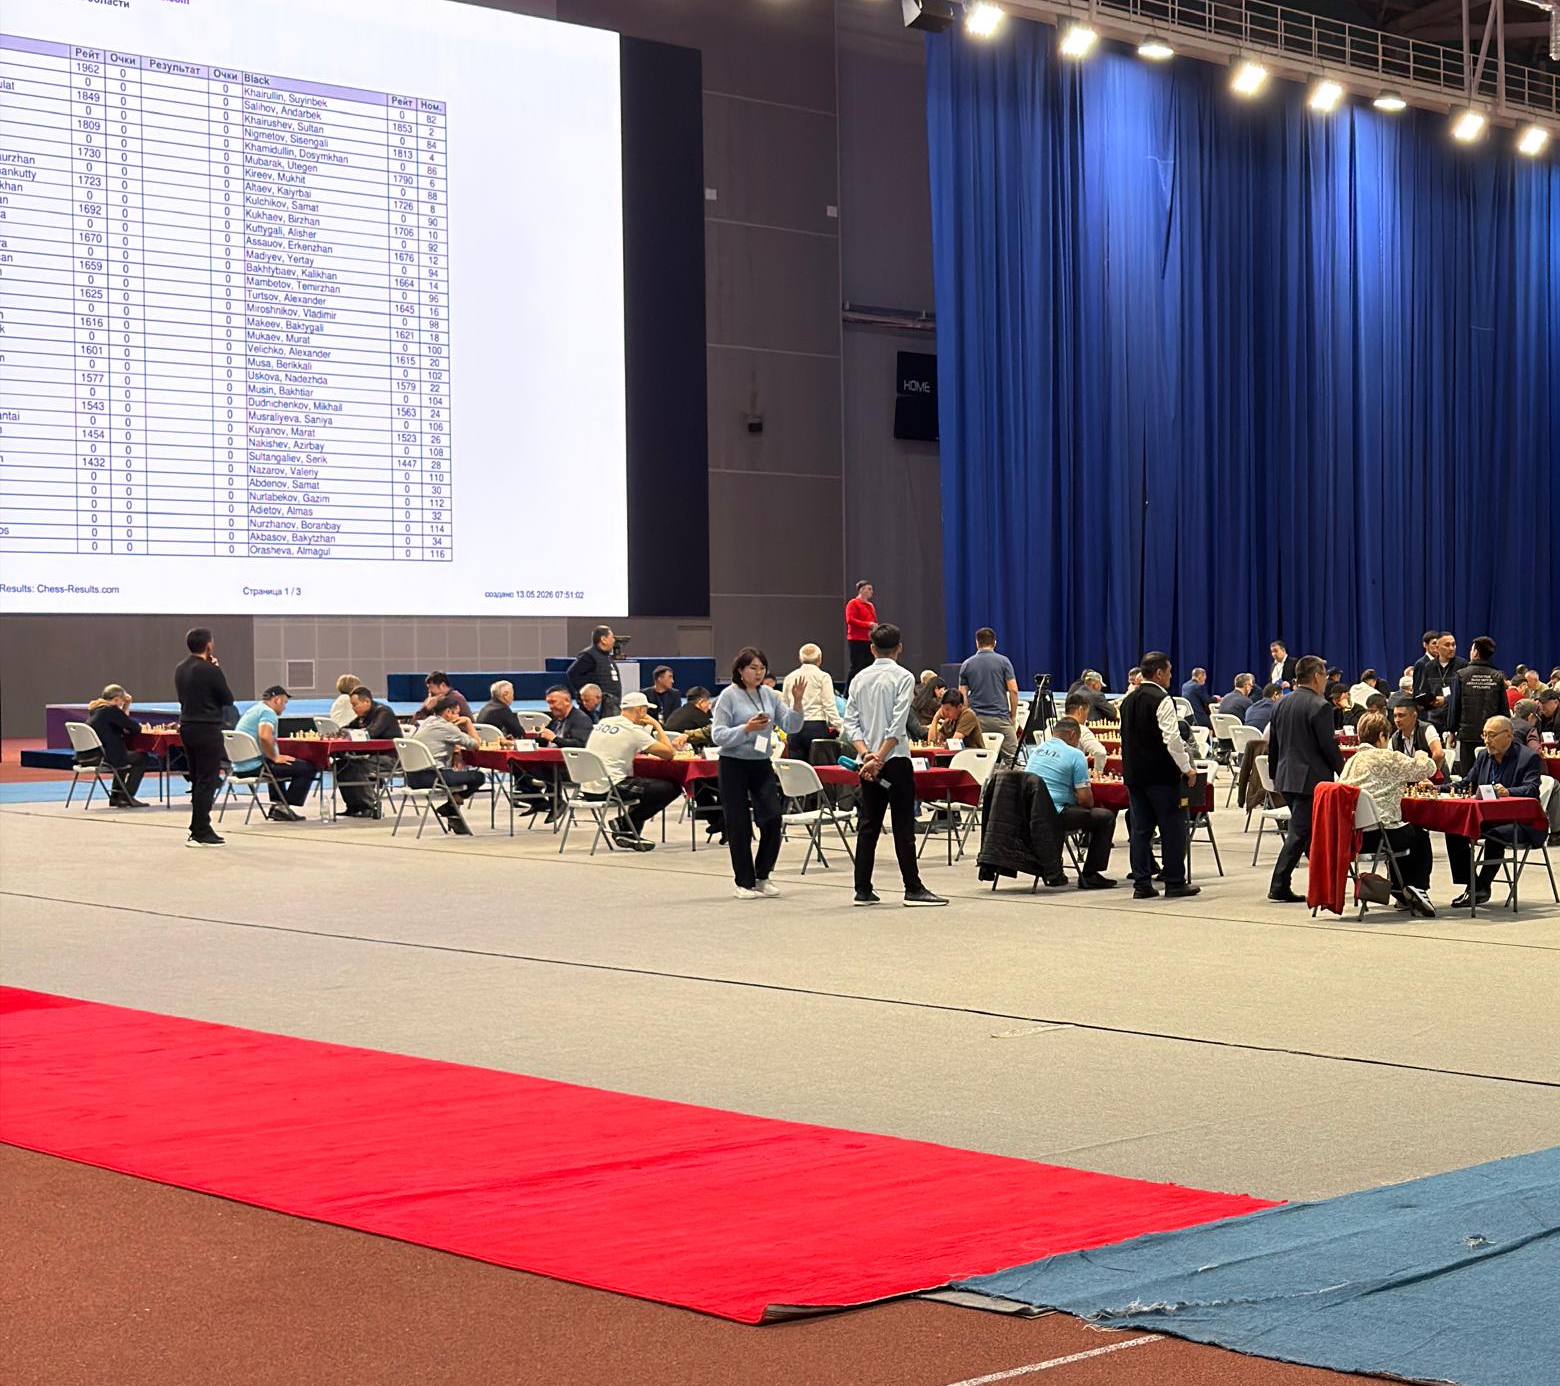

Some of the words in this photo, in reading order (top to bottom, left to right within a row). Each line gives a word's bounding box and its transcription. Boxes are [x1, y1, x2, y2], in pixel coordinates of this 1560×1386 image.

[76, 47, 100, 60] Рейт
[110, 53, 136, 65] Очки
[77, 63, 100, 74] 1962
[150, 59, 200, 75] Результат
[213, 69, 237, 81] Очки
[244, 73, 270, 85] Black
[77, 91, 100, 102] 1849
[244, 88, 287, 103] Khairullin,
[288, 94, 328, 109] Suyinbek
[392, 96, 413, 107] Рейт
[421, 100, 442, 112] Ном.
[281, 106, 322, 120] Andarbek
[78, 120, 100, 131] 1809
[245, 114, 295, 131] Khairushev,
[297, 122, 324, 134] Sultan
[393, 123, 412, 133] 1853
[245, 128, 288, 144] Nigmetov,
[78, 147, 101, 159] 1730
[245, 142, 297, 158] Khamidullin,
[393, 149, 413, 159] 1813
[245, 155, 284, 170] Mubarak,
[287, 161, 318, 173] Utegen
[245, 168, 275, 181] Kireev,
[79, 175, 101, 187] 1723
[394, 175, 413, 185] 1790
[246, 195, 289, 211] Kulchikov,
[292, 200, 319, 212] Samat
[394, 201, 413, 211] 1726
[80, 204, 101, 215] 1692
[246, 209, 285, 224] Kukhaev,
[288, 214, 320, 226] Birzhan
[288, 228, 317, 239] Alisher
[394, 227, 414, 237] 1706
[80, 233, 102, 243] 1670
[246, 236, 285, 249] Assauov,
[288, 240, 333, 253] Erkenzhan
[287, 254, 314, 267] Yertay
[429, 256, 438, 265] 12
[80, 261, 102, 271] 1659
[428, 269, 438, 278] 94
[429, 282, 438, 290] 14
[80, 289, 103, 299] 1625
[246, 290, 281, 302] Turtsov,
[284, 293, 326, 305] Alexander
[429, 294, 439, 303] 96
[247, 303, 300, 317] Miroshnikov,
[303, 308, 336, 319] Vladimir
[430, 307, 439, 317] 16
[81, 317, 103, 328] 1616
[247, 317, 283, 329] Makeev,
[429, 320, 439, 329] 98
[247, 331, 283, 342] Mukaev,
[286, 334, 310, 344] Murat
[396, 331, 414, 340] 1621
[430, 333, 439, 342] 18
[81, 345, 102, 355] 1601
[289, 347, 331, 359] Alexander
[428, 346, 442, 355] 100
[248, 357, 274, 369] Musa,
[396, 356, 416, 365] 1615
[430, 358, 440, 367] 20
[82, 373, 104, 383] 1577
[248, 371, 282, 382] Uskova,
[285, 373, 328, 385] Nadezhda
[428, 371, 442, 380] 102
[248, 384, 276, 396] Musin,
[279, 386, 314, 397] Bakhtiar
[397, 382, 416, 391] 1579
[430, 384, 440, 393] 22
[903, 379, 931, 393] HOME
[82, 401, 104, 411] 1543
[429, 397, 443, 405] 104
[313, 402, 342, 412] Mikhail
[397, 407, 416, 417] 1563
[430, 409, 440, 418] 24
[304, 414, 333, 426] Saniya
[83, 430, 105, 439] 1454
[249, 425, 288, 436] Kuyanov,
[291, 427, 315, 437] Marat
[398, 434, 417, 443] 1523
[431, 435, 441, 444] 26
[249, 438, 291, 449] Nakishev,
[293, 441, 325, 452] Azirbay
[429, 448, 444, 457] 108
[83, 457, 105, 467] 1432
[398, 459, 417, 468] 1447
[431, 461, 441, 469] 28
[249, 465, 287, 476] Nazarov,
[430, 473, 444, 482] 110
[249, 478, 289, 489] Abdenov,
[292, 479, 319, 490] Samat
[432, 486, 442, 495] 30
[303, 493, 330, 503] Gazim
[430, 499, 444, 508] 112
[432, 511, 442, 521] 32
[250, 519, 298, 529] Nurzhanov,
[301, 520, 341, 531] Boranbay
[430, 525, 444, 533] 114
[250, 532, 289, 542] Akbasov,
[292, 533, 336, 544] Bakytzhan
[432, 537, 442, 546] 34
[250, 545, 294, 555] Orasheva,
[37, 584, 120, 594] Chess-Results.com
[242, 586, 282, 597] Страница
[285, 587, 289, 596] 1
[296, 587, 302, 596] 3
[516, 591, 554, 599] 13.05.2026
[555, 591, 584, 599] 07:51:02
